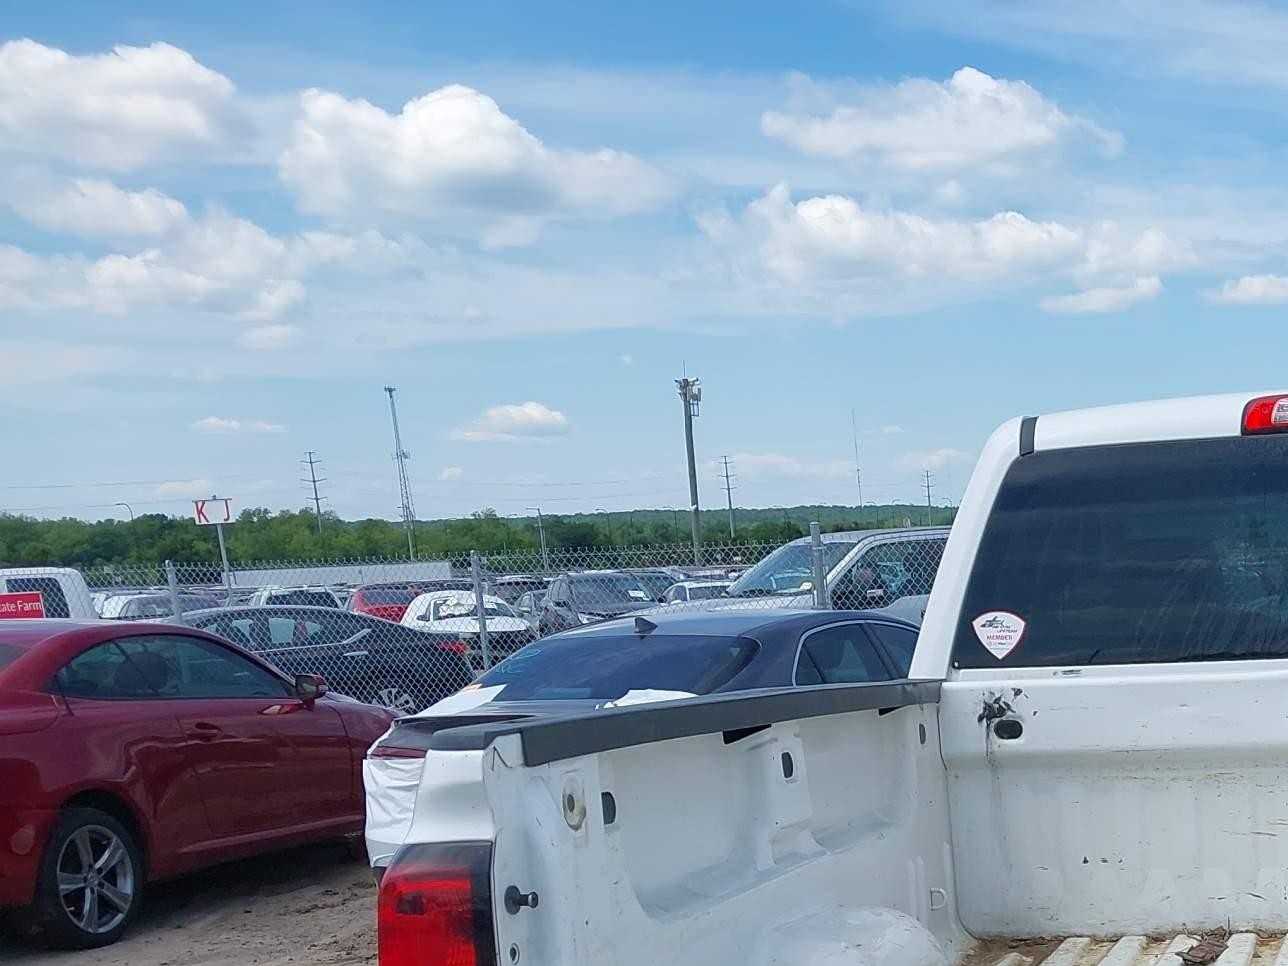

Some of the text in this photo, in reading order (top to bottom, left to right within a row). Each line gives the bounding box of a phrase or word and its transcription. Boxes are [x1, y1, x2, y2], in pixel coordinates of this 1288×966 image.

[195, 499, 230, 523] K J
[17, 600, 42, 612] Farm
